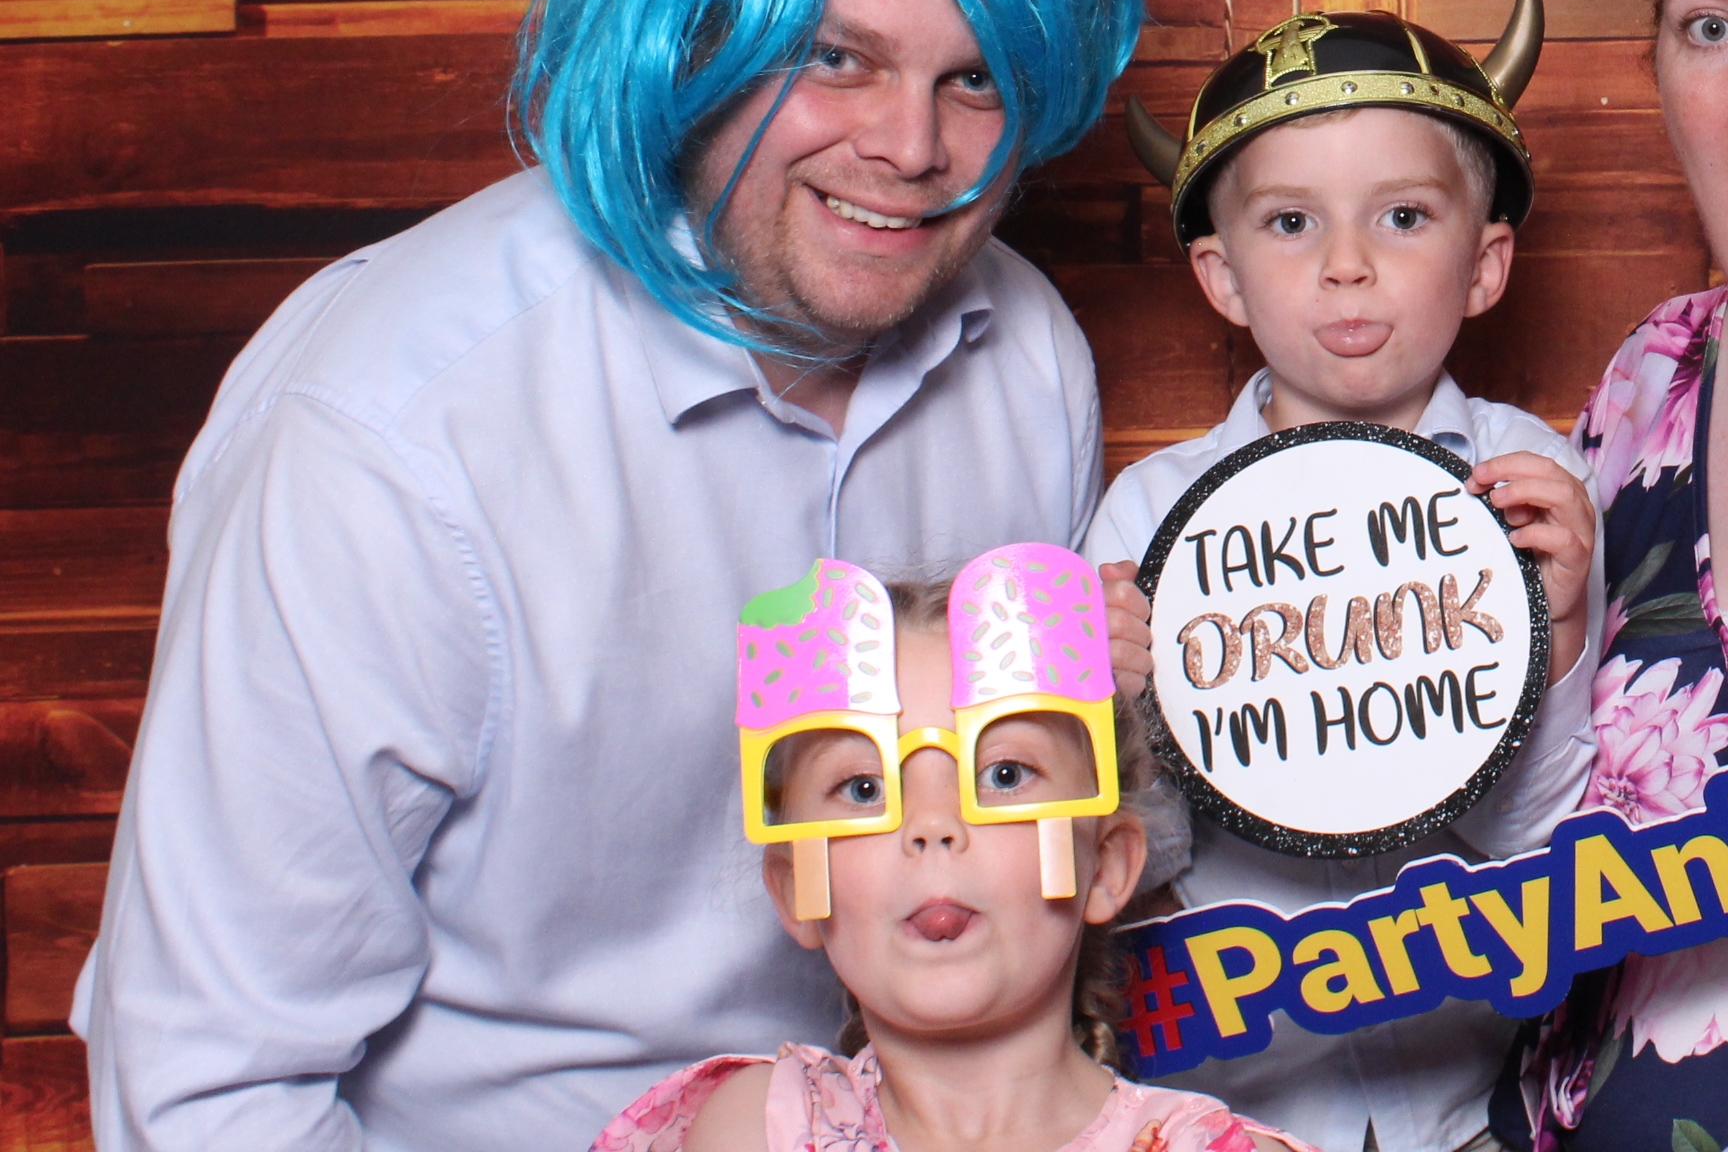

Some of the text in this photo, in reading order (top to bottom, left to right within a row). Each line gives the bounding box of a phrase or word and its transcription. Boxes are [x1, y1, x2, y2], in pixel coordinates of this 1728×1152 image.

[1184, 487, 1469, 596] TAKE ME
[1177, 568, 1504, 690] DRUNK
[1192, 662, 1507, 773] I'M HOME
